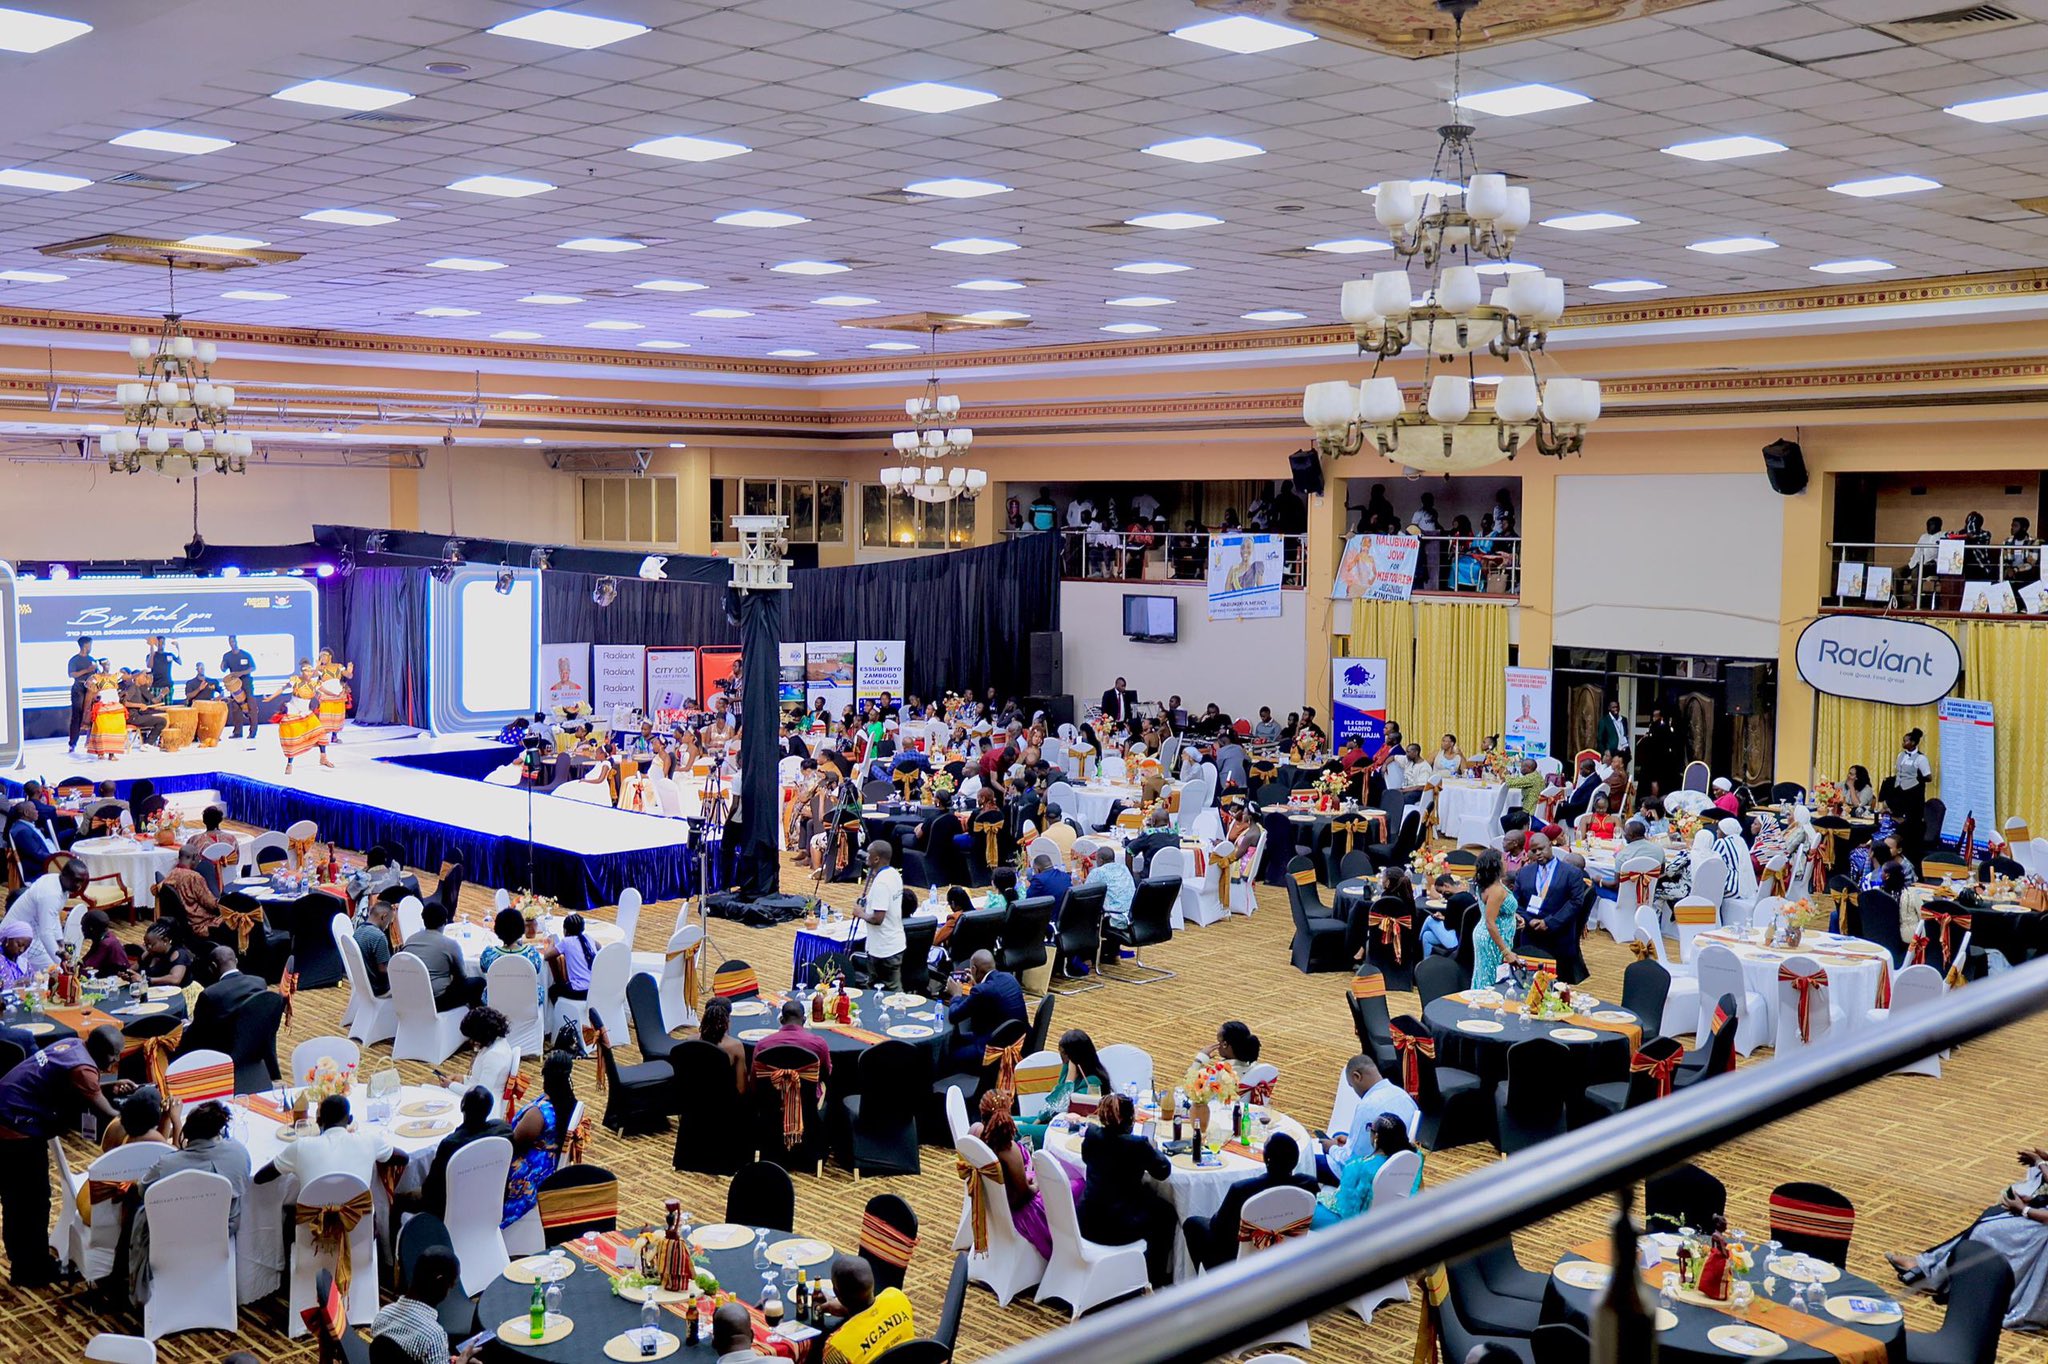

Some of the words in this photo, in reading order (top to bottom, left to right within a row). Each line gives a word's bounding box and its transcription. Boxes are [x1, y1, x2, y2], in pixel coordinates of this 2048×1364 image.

[66, 607, 128, 628] Big
[174, 612, 213, 629] you
[603, 650, 635, 660] Radiant
[1818, 639, 1932, 676] Radiant
[603, 666, 635, 676] Radiant
[603, 682, 635, 692] Radiant
[860, 1310, 910, 1355] NGANDA
